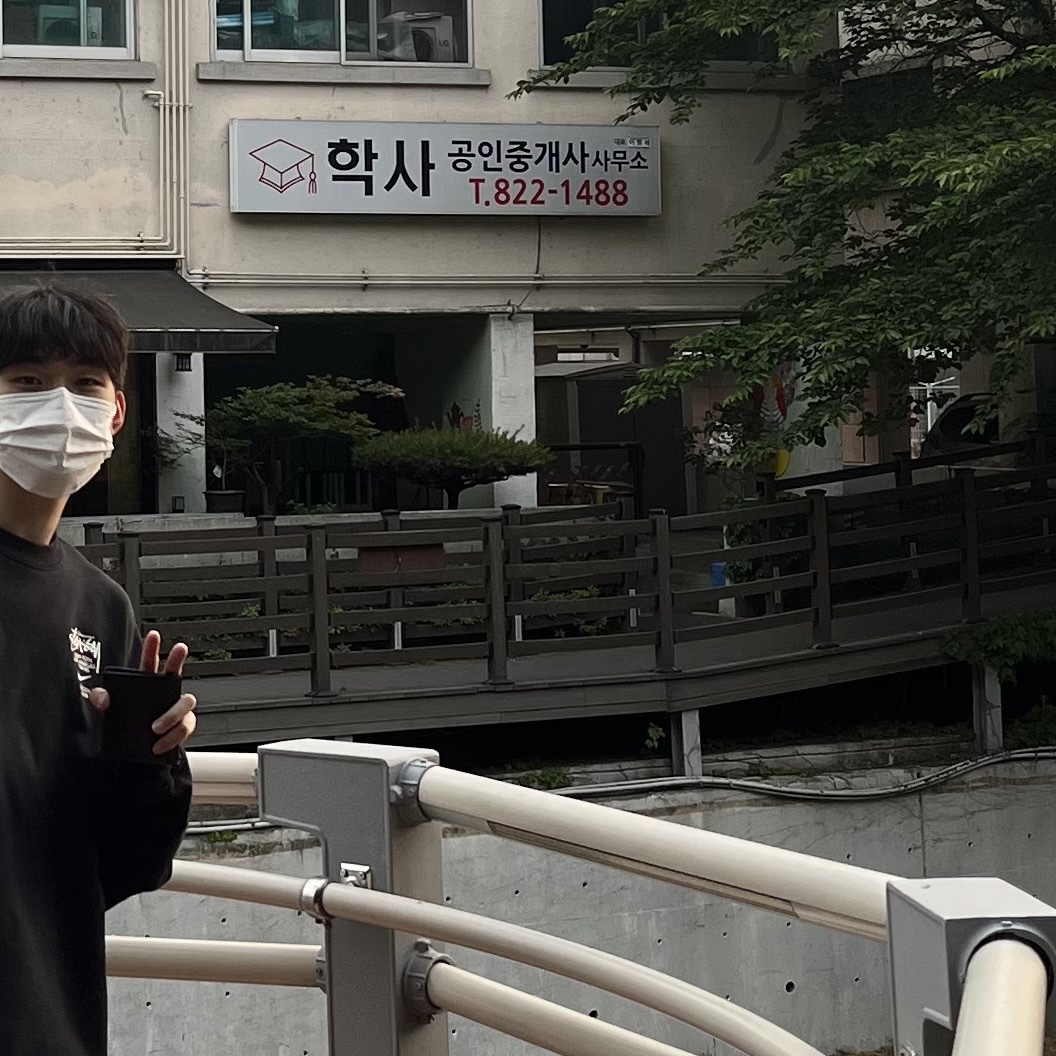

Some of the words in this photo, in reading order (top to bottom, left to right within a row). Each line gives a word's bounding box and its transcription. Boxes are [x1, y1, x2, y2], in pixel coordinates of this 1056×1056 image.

[438, 39, 449, 48] LG
[327, 138, 436, 197] 학사
[447, 139, 590, 174] 공인중개사
[591, 149, 650, 173] 사무소
[468, 177, 630, 208] T.822-1488
